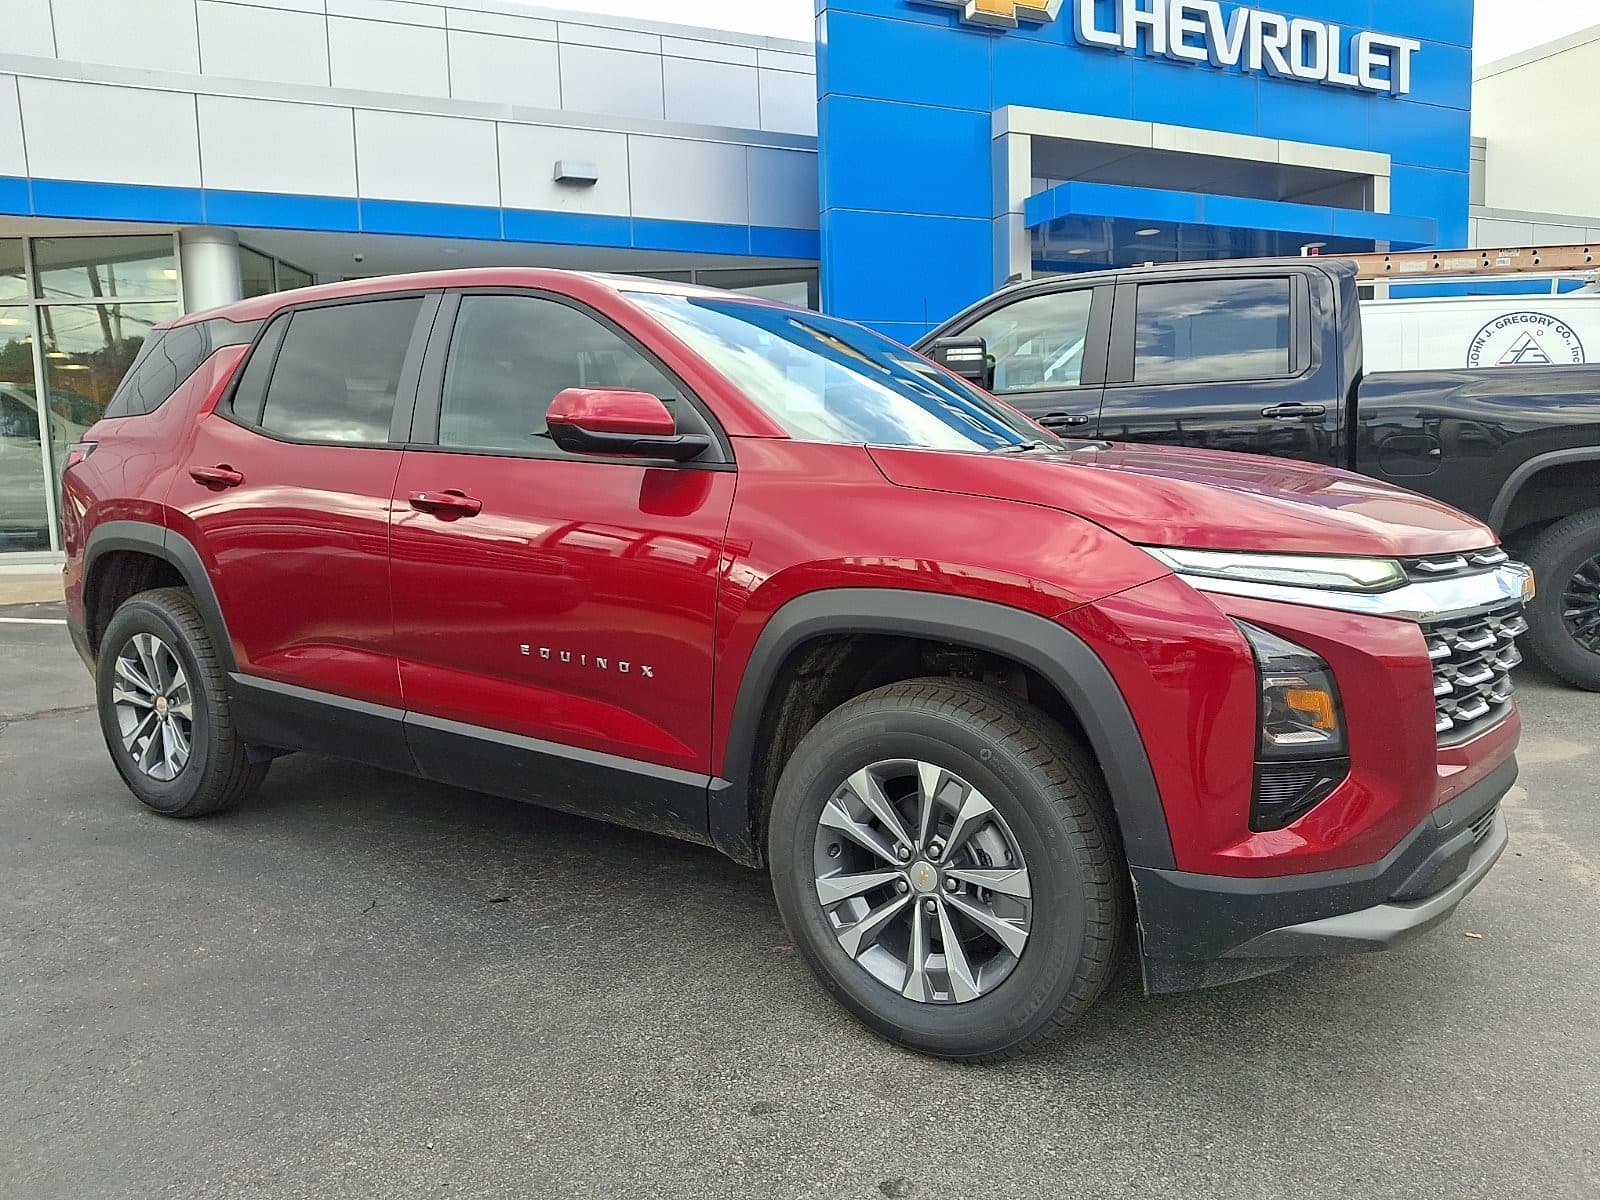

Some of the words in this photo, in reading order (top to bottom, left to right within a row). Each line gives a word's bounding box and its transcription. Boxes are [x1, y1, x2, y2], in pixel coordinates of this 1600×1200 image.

[1075, 0, 1421, 95] CHEVROLET
[1470, 337, 1486, 367] JOHN
[1485, 329, 1495, 338] J.
[1495, 315, 1555, 329] GREGORY
[519, 644, 654, 678] EQUINOX
